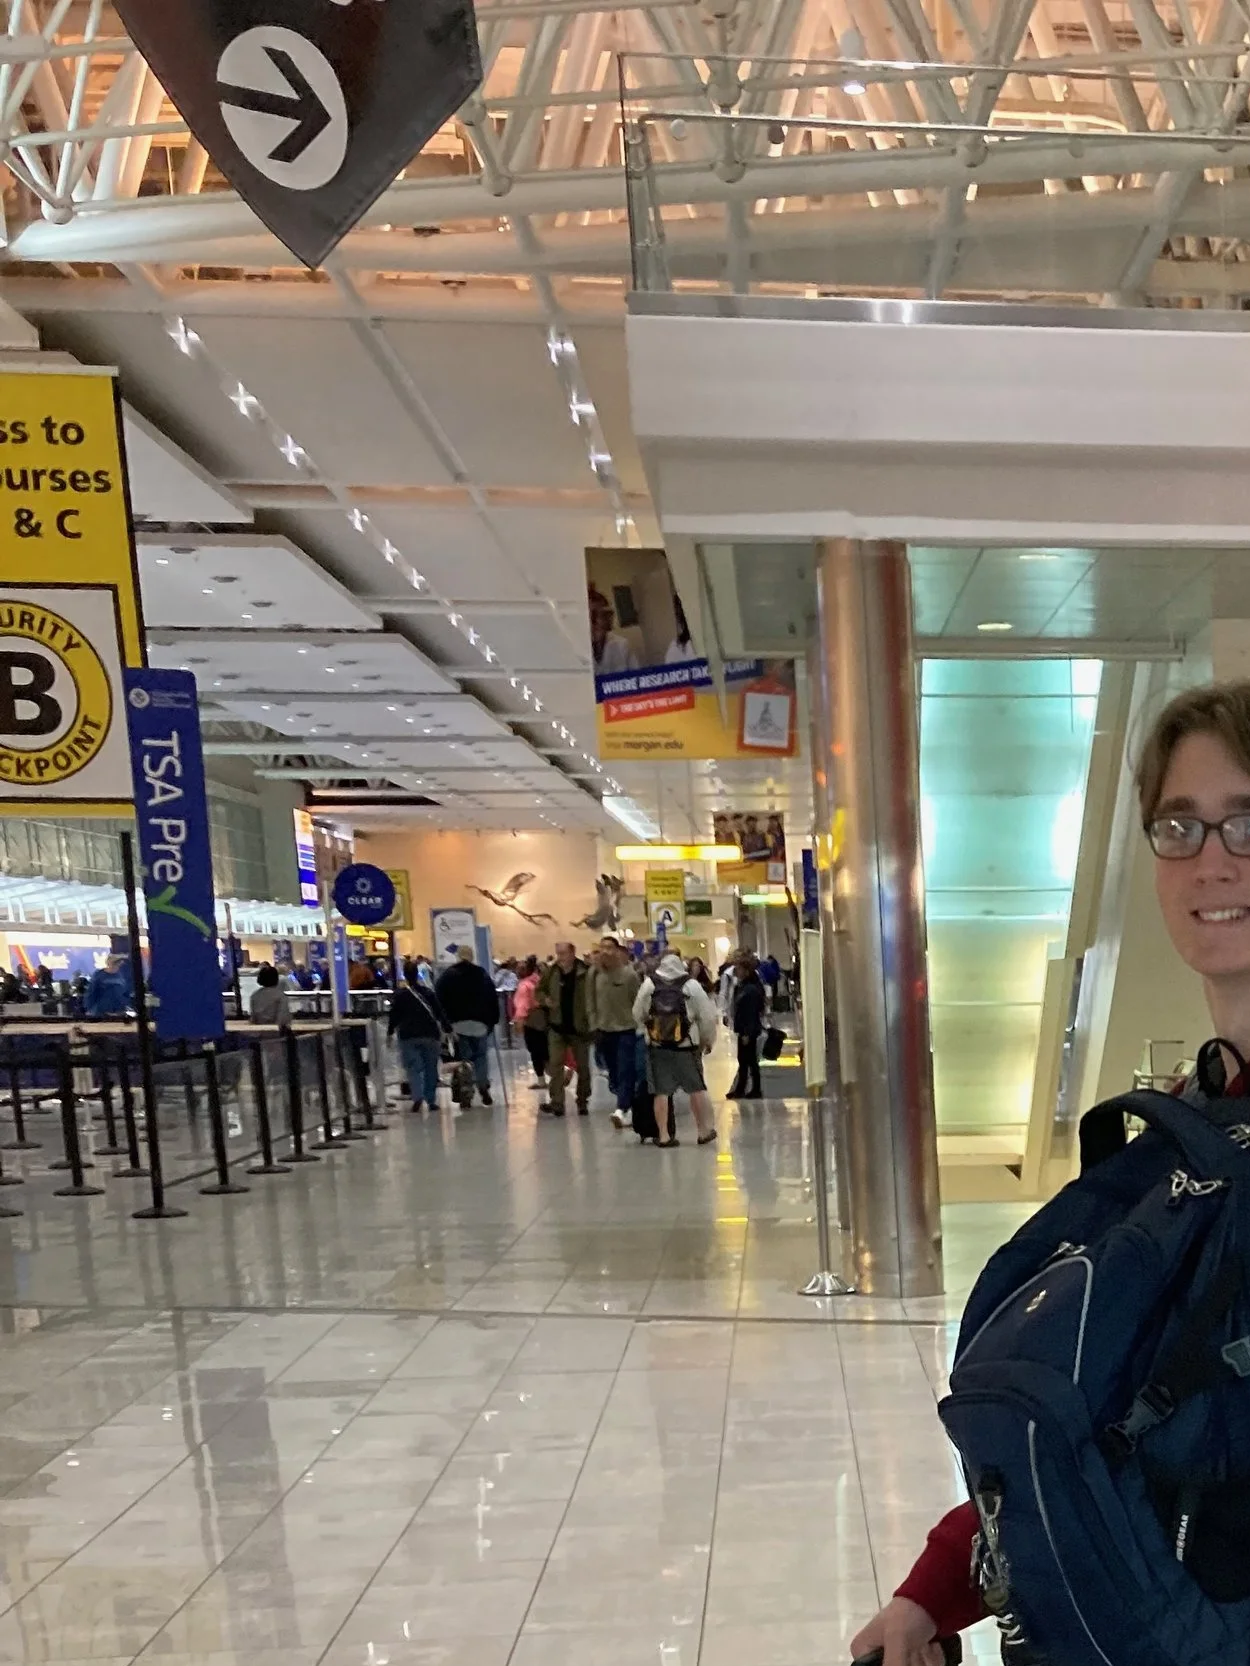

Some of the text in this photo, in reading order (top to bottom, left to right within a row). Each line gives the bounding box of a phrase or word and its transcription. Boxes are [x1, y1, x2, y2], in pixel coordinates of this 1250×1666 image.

[40, 416, 84, 445] to
[0, 467, 112, 493] urses
[14, 508, 82, 539] & C
[0, 651, 62, 735] B
[602, 678, 637, 694] WHERE
[639, 669, 689, 688] RESEARCH
[142, 730, 183, 807] TSA
[149, 818, 187, 883] Pre
[347, 896, 383, 905] CLEAR
[662, 910, 673, 923] A
